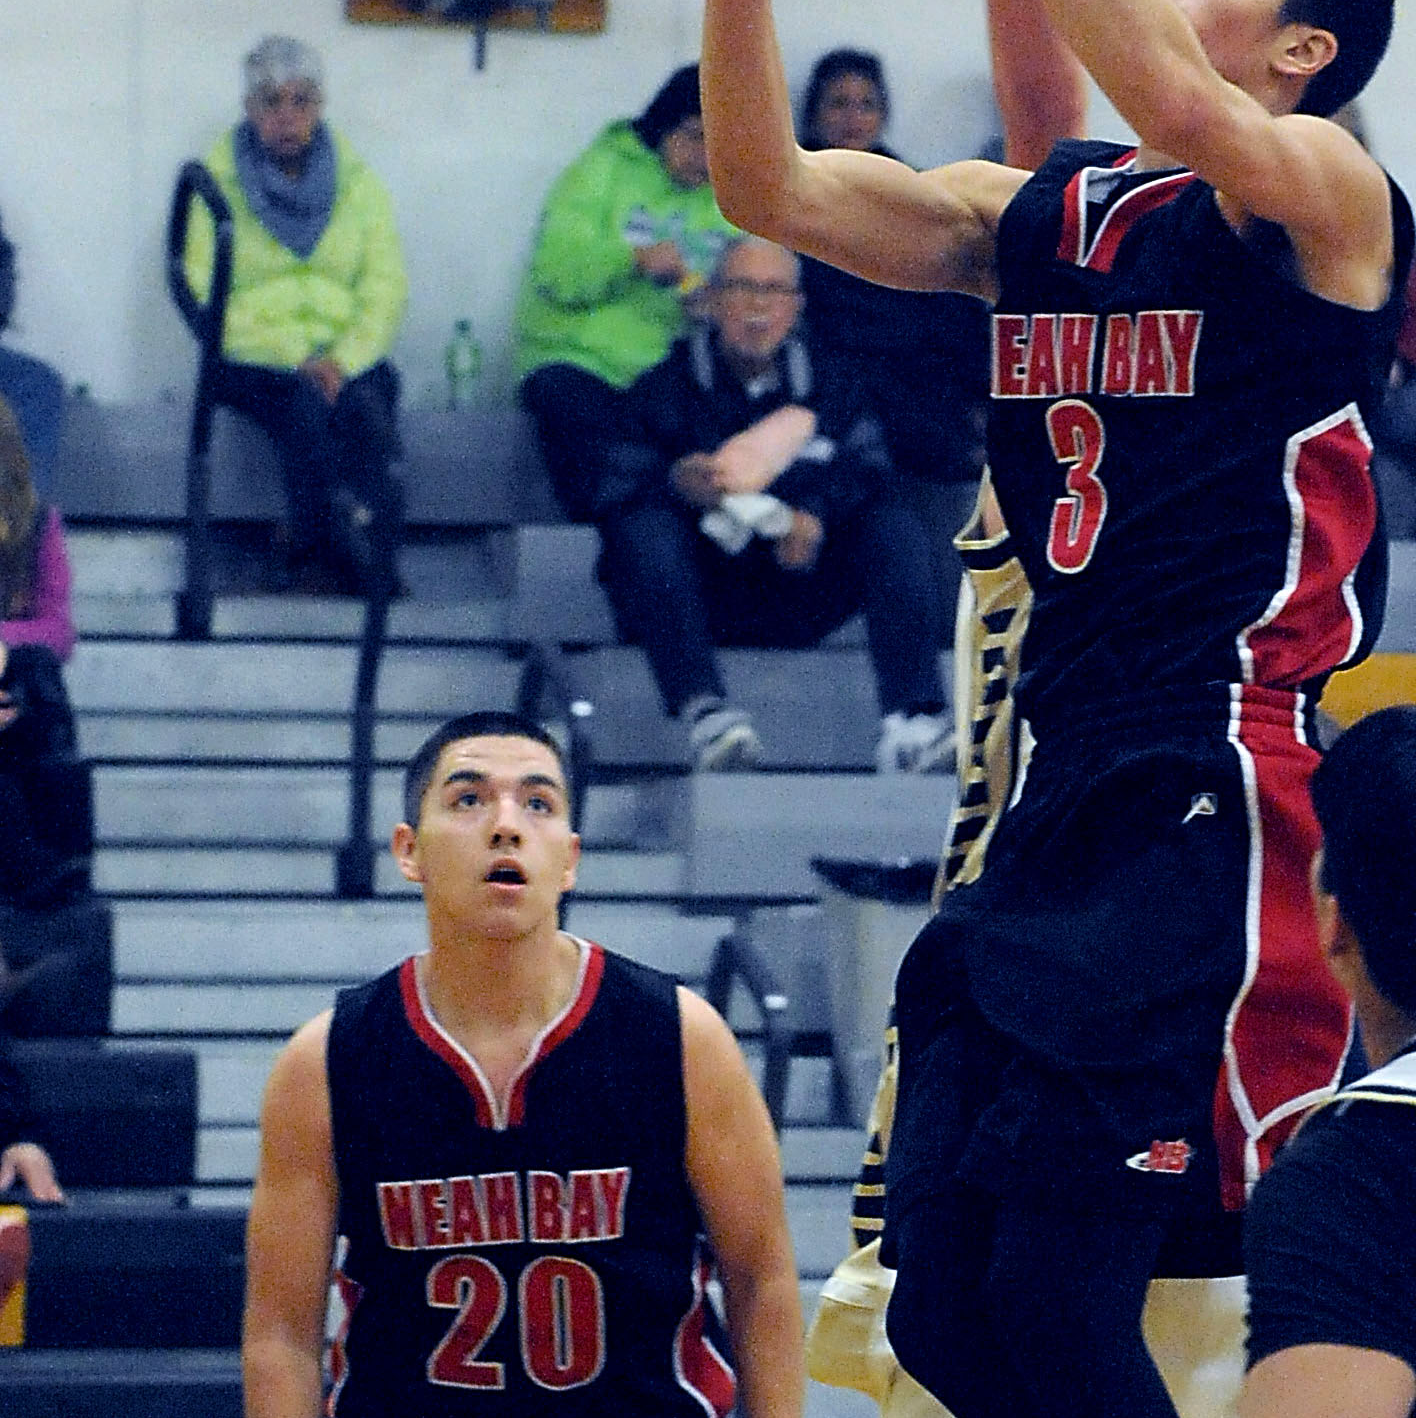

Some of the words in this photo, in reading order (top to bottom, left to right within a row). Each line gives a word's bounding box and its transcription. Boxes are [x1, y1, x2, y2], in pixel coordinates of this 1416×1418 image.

[990, 313, 1098, 399] EAH
[1099, 309, 1204, 398] BAY
[1046, 399, 1107, 575] 3
[376, 1172, 525, 1251] NEAH
[526, 1166, 632, 1244] BAY
[426, 1254, 606, 1391] 20
